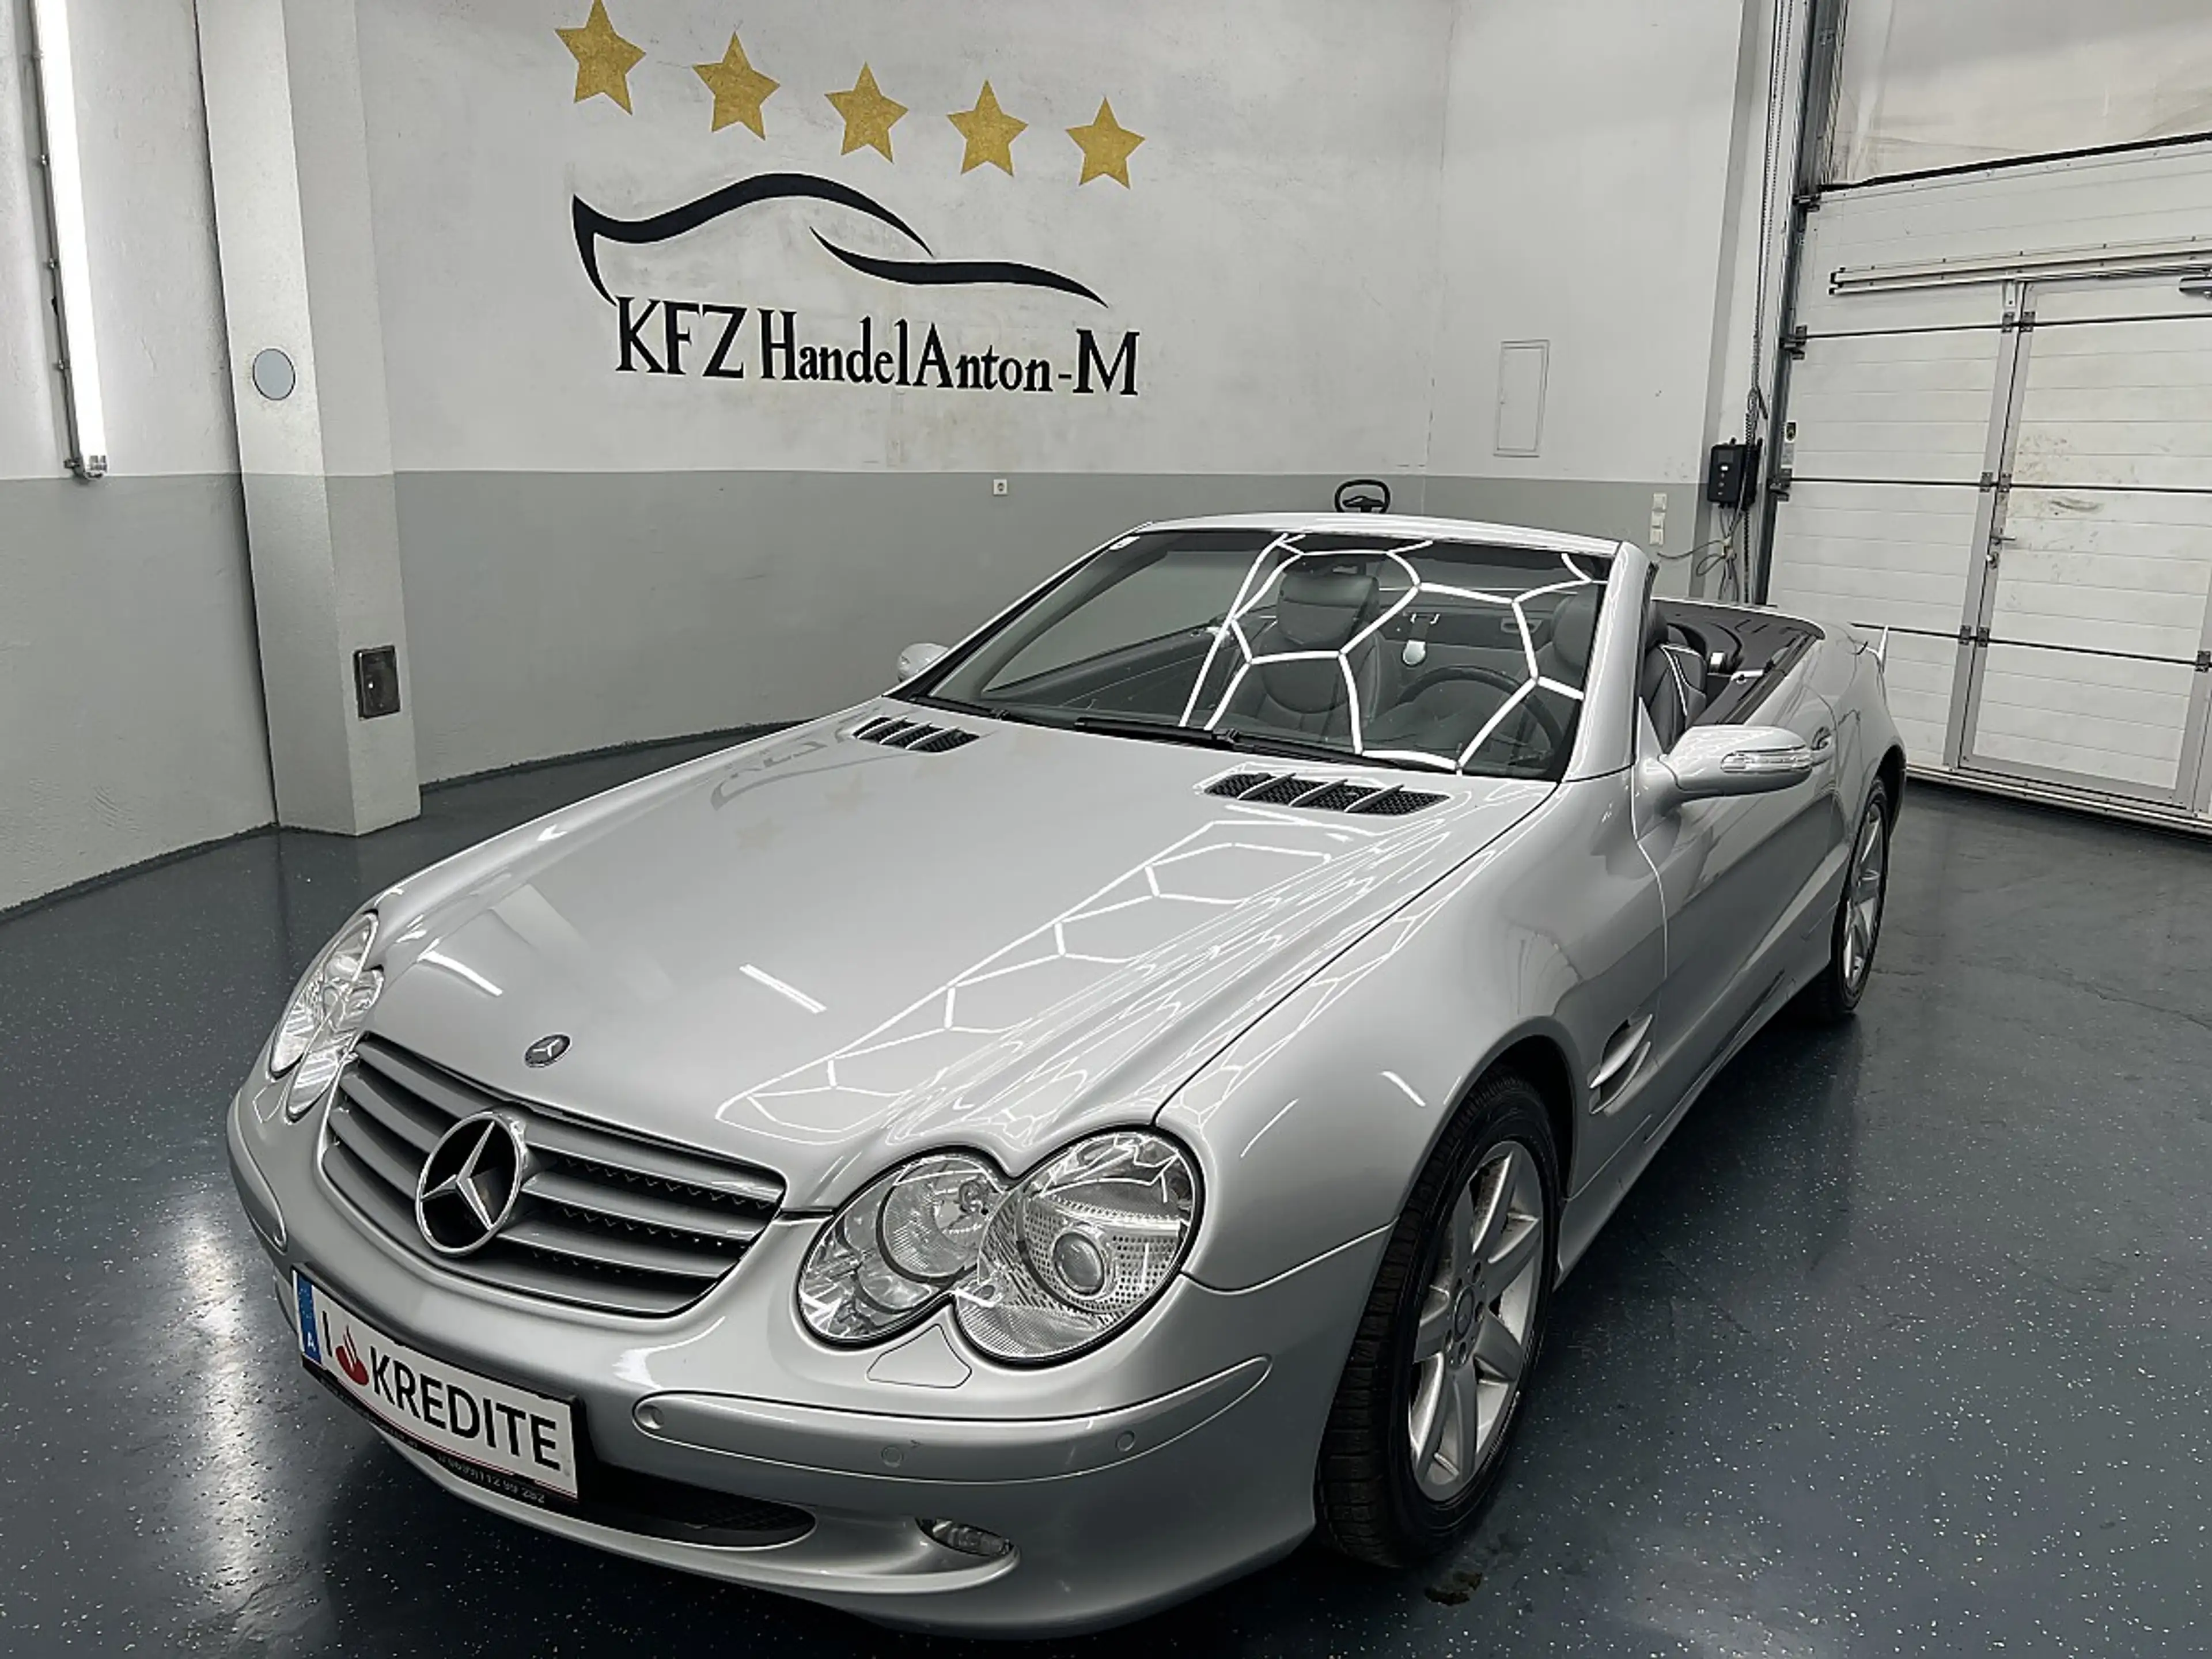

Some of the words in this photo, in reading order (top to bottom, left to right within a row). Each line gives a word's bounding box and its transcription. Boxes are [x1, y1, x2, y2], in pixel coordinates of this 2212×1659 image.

[616, 296, 747, 379] KFZ
[321, 1310, 333, 1358] I
[370, 1345, 561, 1472] KREDITE
